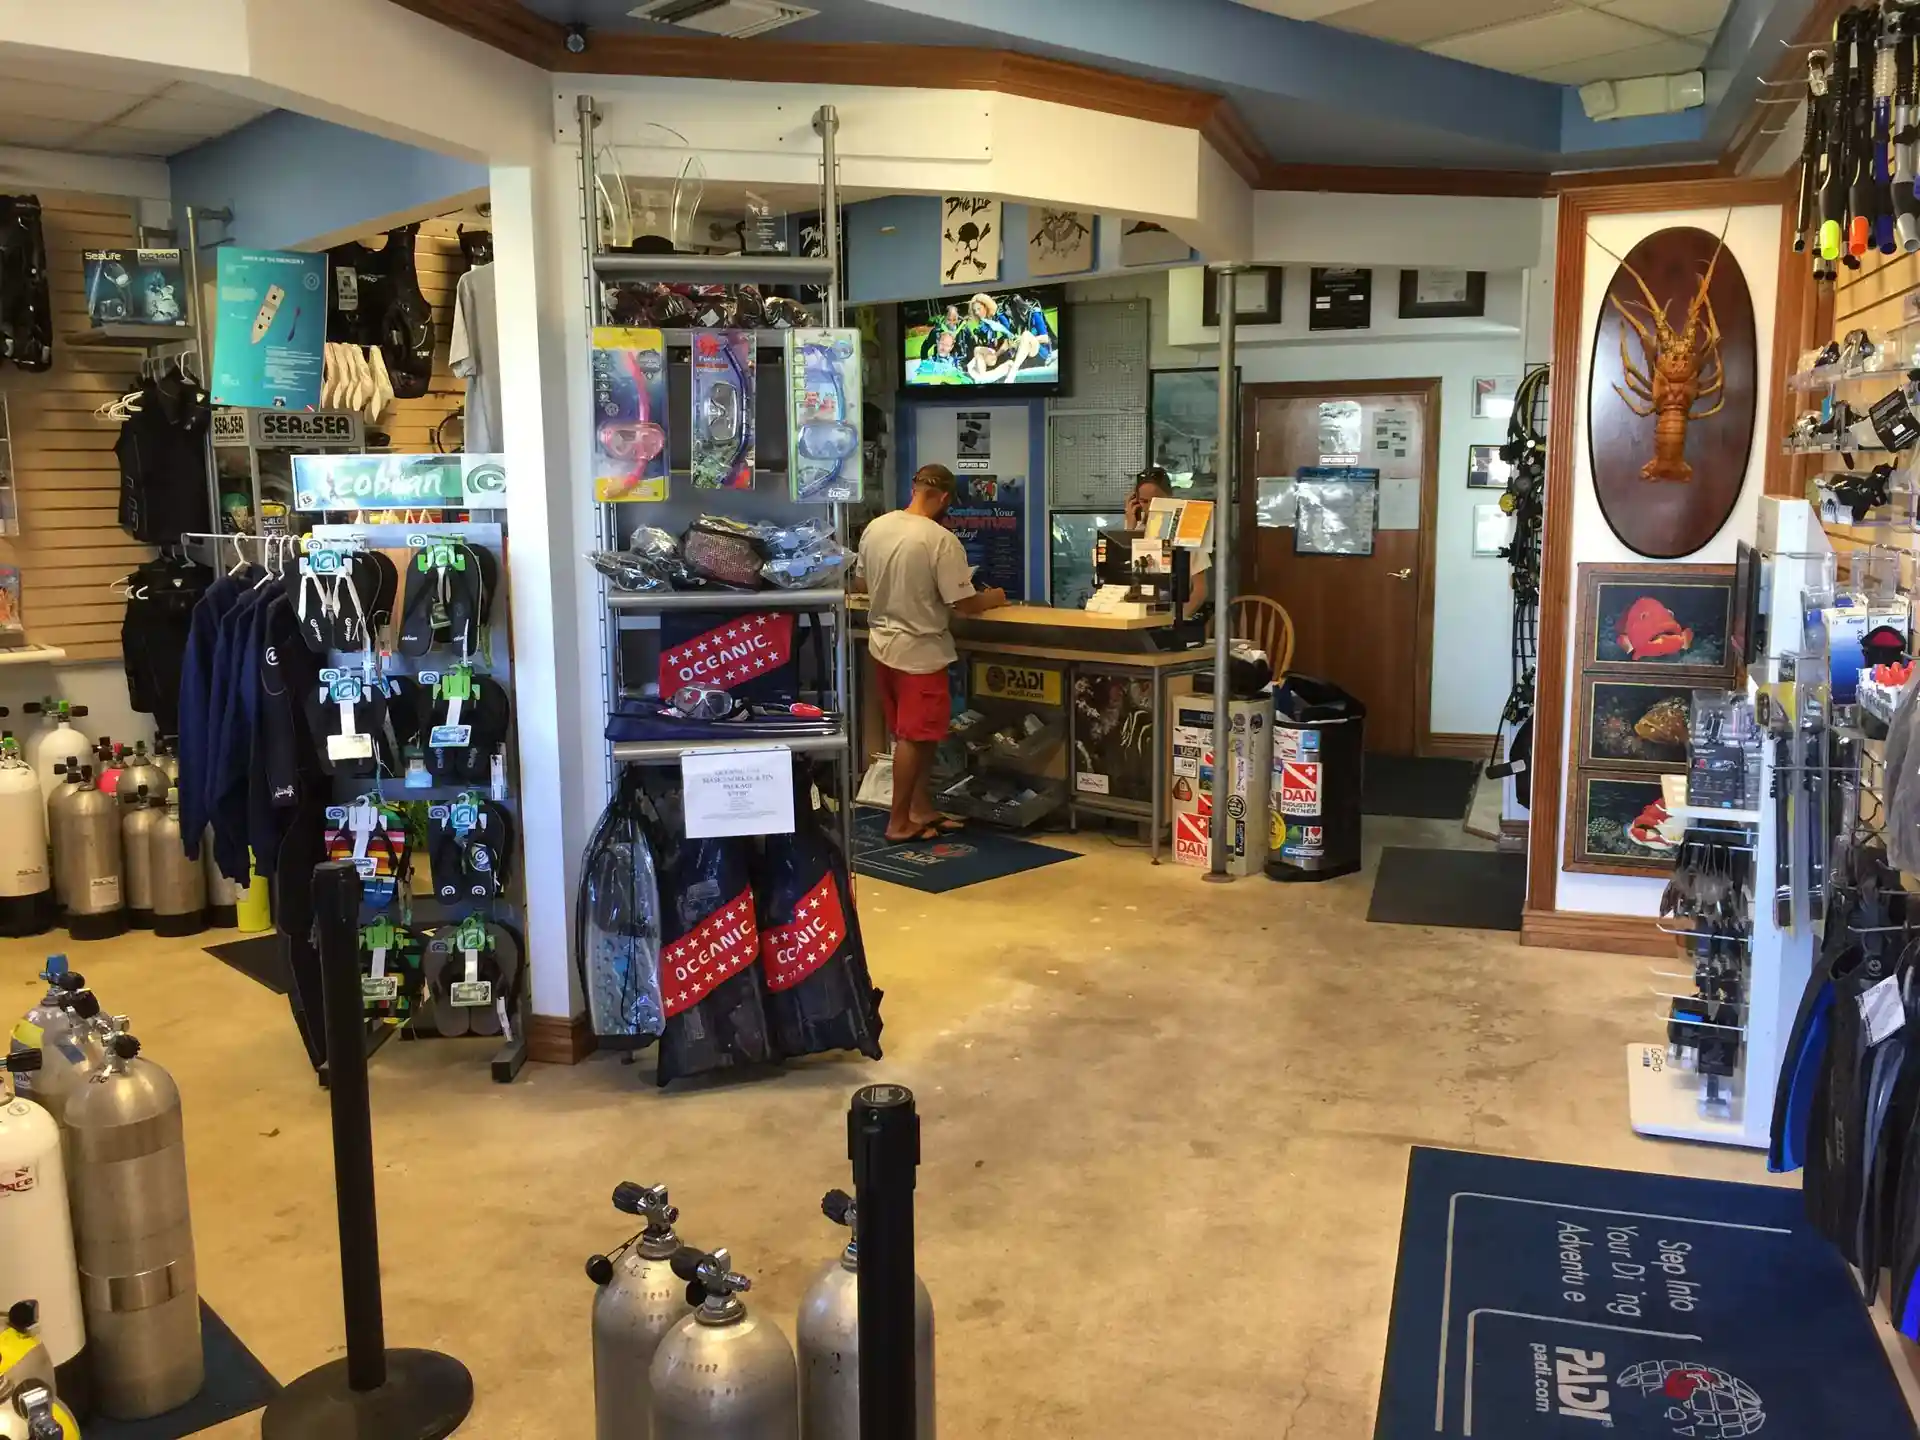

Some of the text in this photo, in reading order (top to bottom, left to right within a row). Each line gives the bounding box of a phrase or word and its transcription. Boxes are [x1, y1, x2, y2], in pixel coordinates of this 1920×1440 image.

[85, 252, 121, 260] SeaLife
[214, 416, 244, 434] SEA&SEA
[264, 416, 350, 434] SEA&SEA
[993, 507, 1015, 517] Your
[680, 635, 767, 682] OCEANIC
[1007, 669, 1044, 691] PADI
[1283, 789, 1316, 802] DAN
[1177, 839, 1207, 857] DAN
[675, 920, 752, 981] OCEANIC
[1651, 1047, 1664, 1072] GoPro
[1605, 1226, 1640, 1259] Your
[1650, 1240, 1701, 1312] Step Into
[1529, 1342, 1553, 1412] padi.com
[1555, 1345, 1612, 1422] PADI
